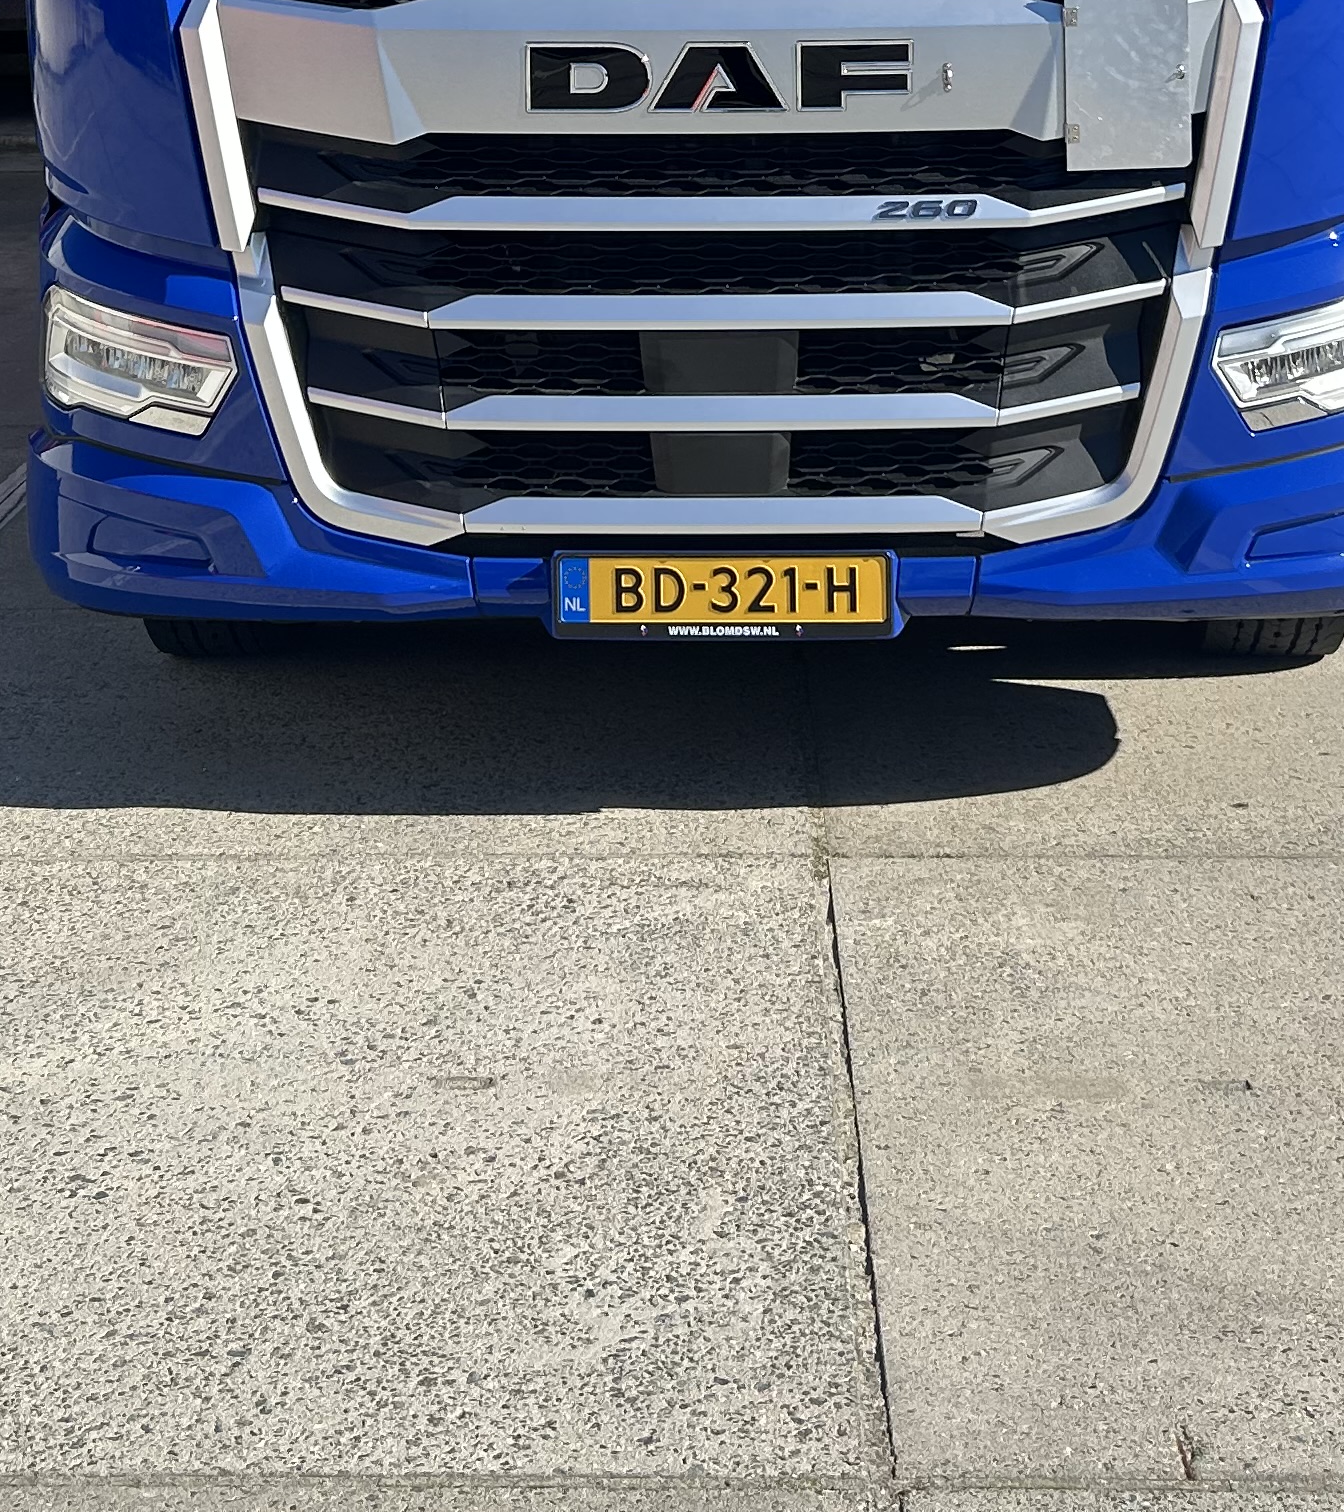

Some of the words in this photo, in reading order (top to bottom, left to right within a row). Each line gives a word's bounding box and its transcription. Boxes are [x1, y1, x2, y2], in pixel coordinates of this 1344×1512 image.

[525, 38, 914, 114] DAF
[874, 199, 978, 221] 260
[564, 596, 586, 612] NL
[613, 564, 860, 614] BD-321-H
